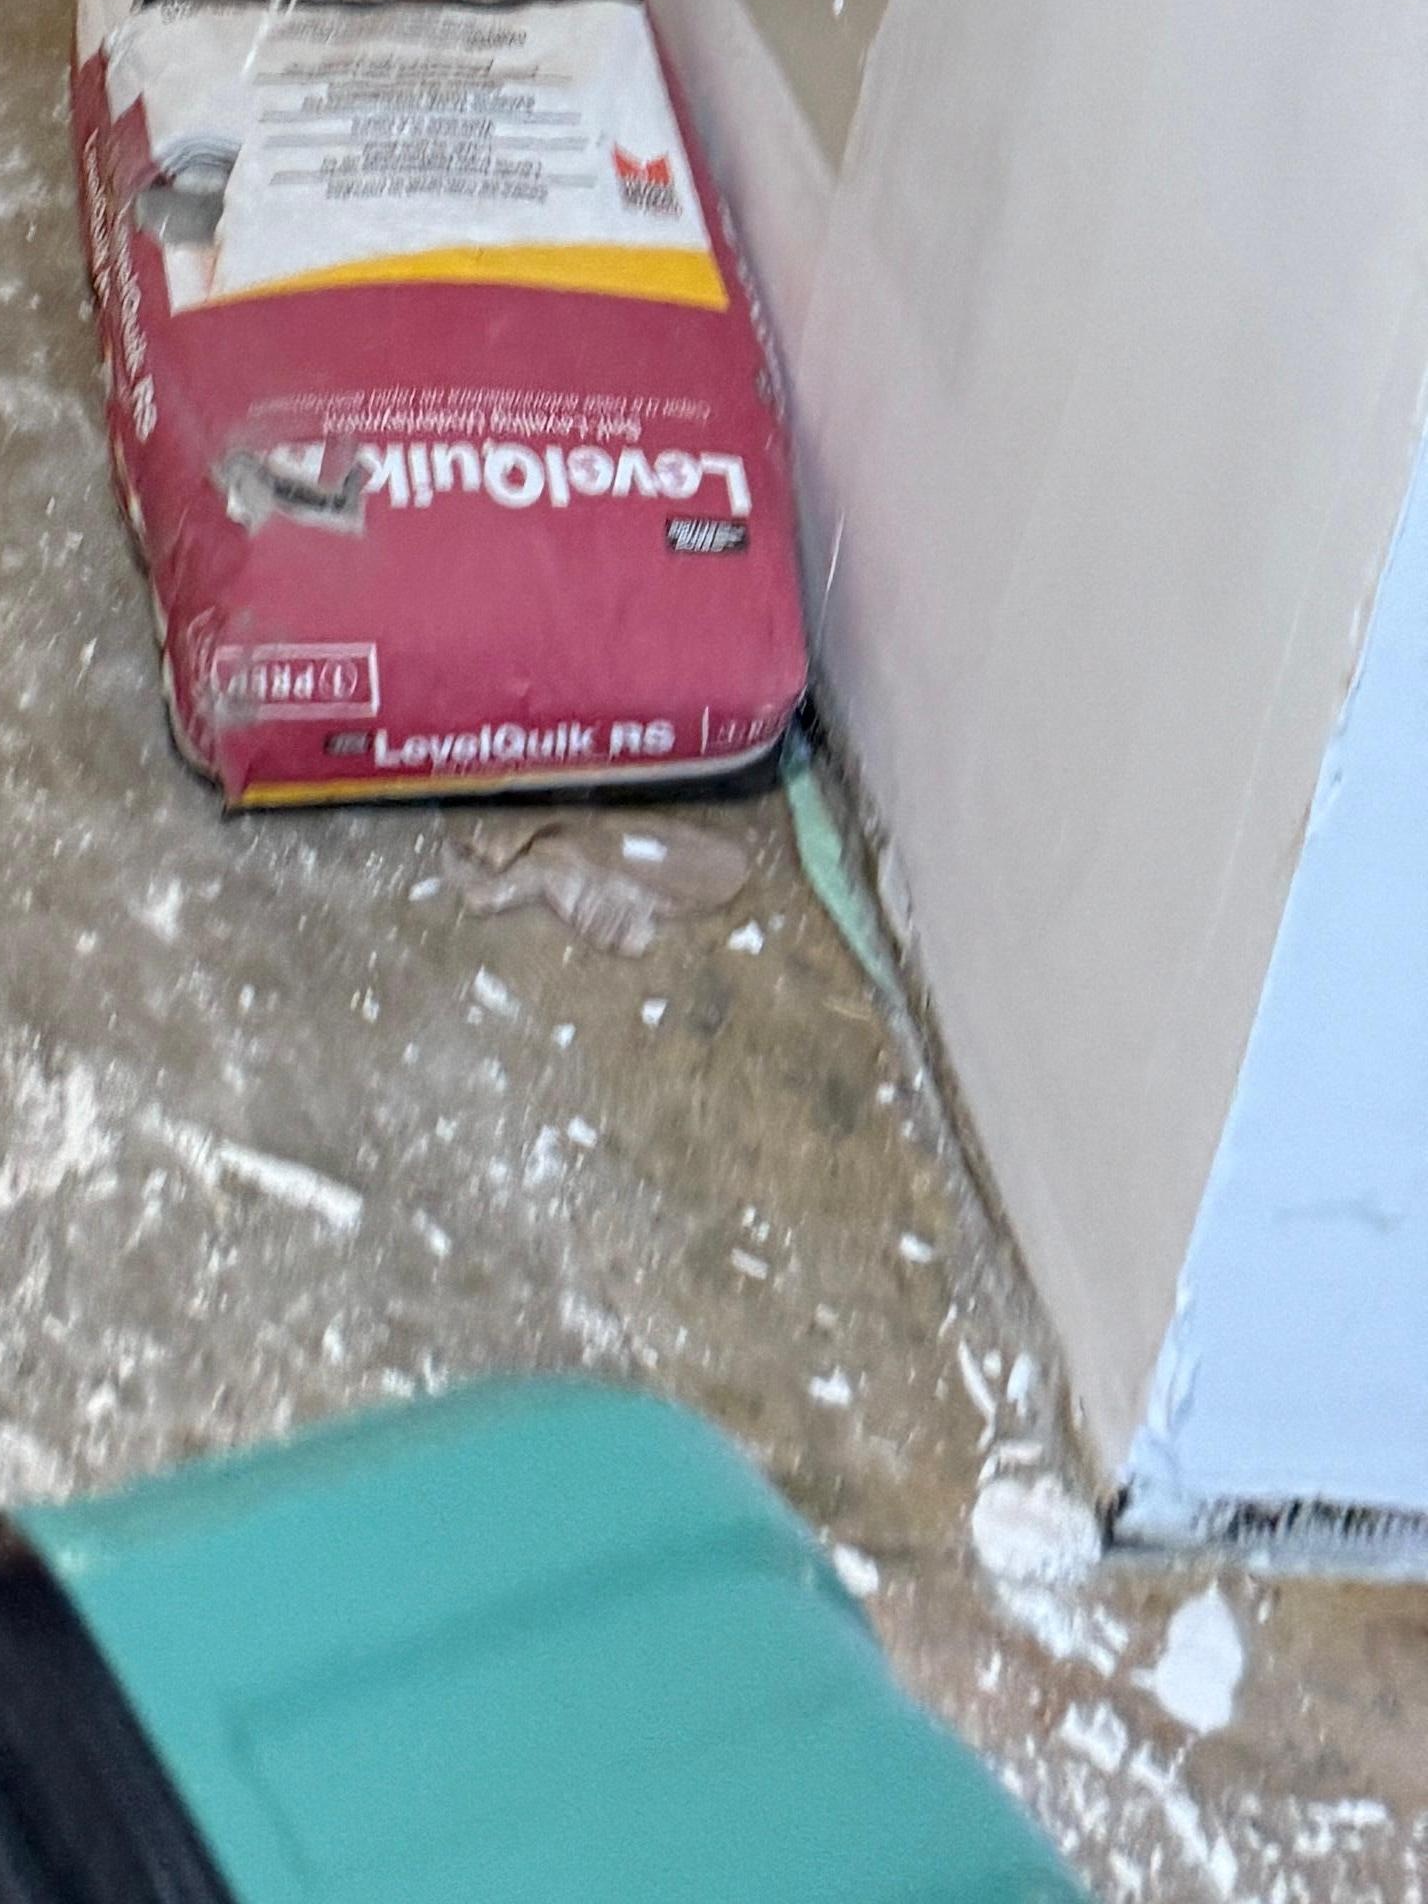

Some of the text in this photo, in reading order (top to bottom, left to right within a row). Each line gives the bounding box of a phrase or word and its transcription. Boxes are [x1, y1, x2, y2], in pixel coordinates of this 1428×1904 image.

[358, 440, 752, 518] LevelQuik
[374, 720, 596, 769] LevelQuik
[609, 719, 676, 760] RS
